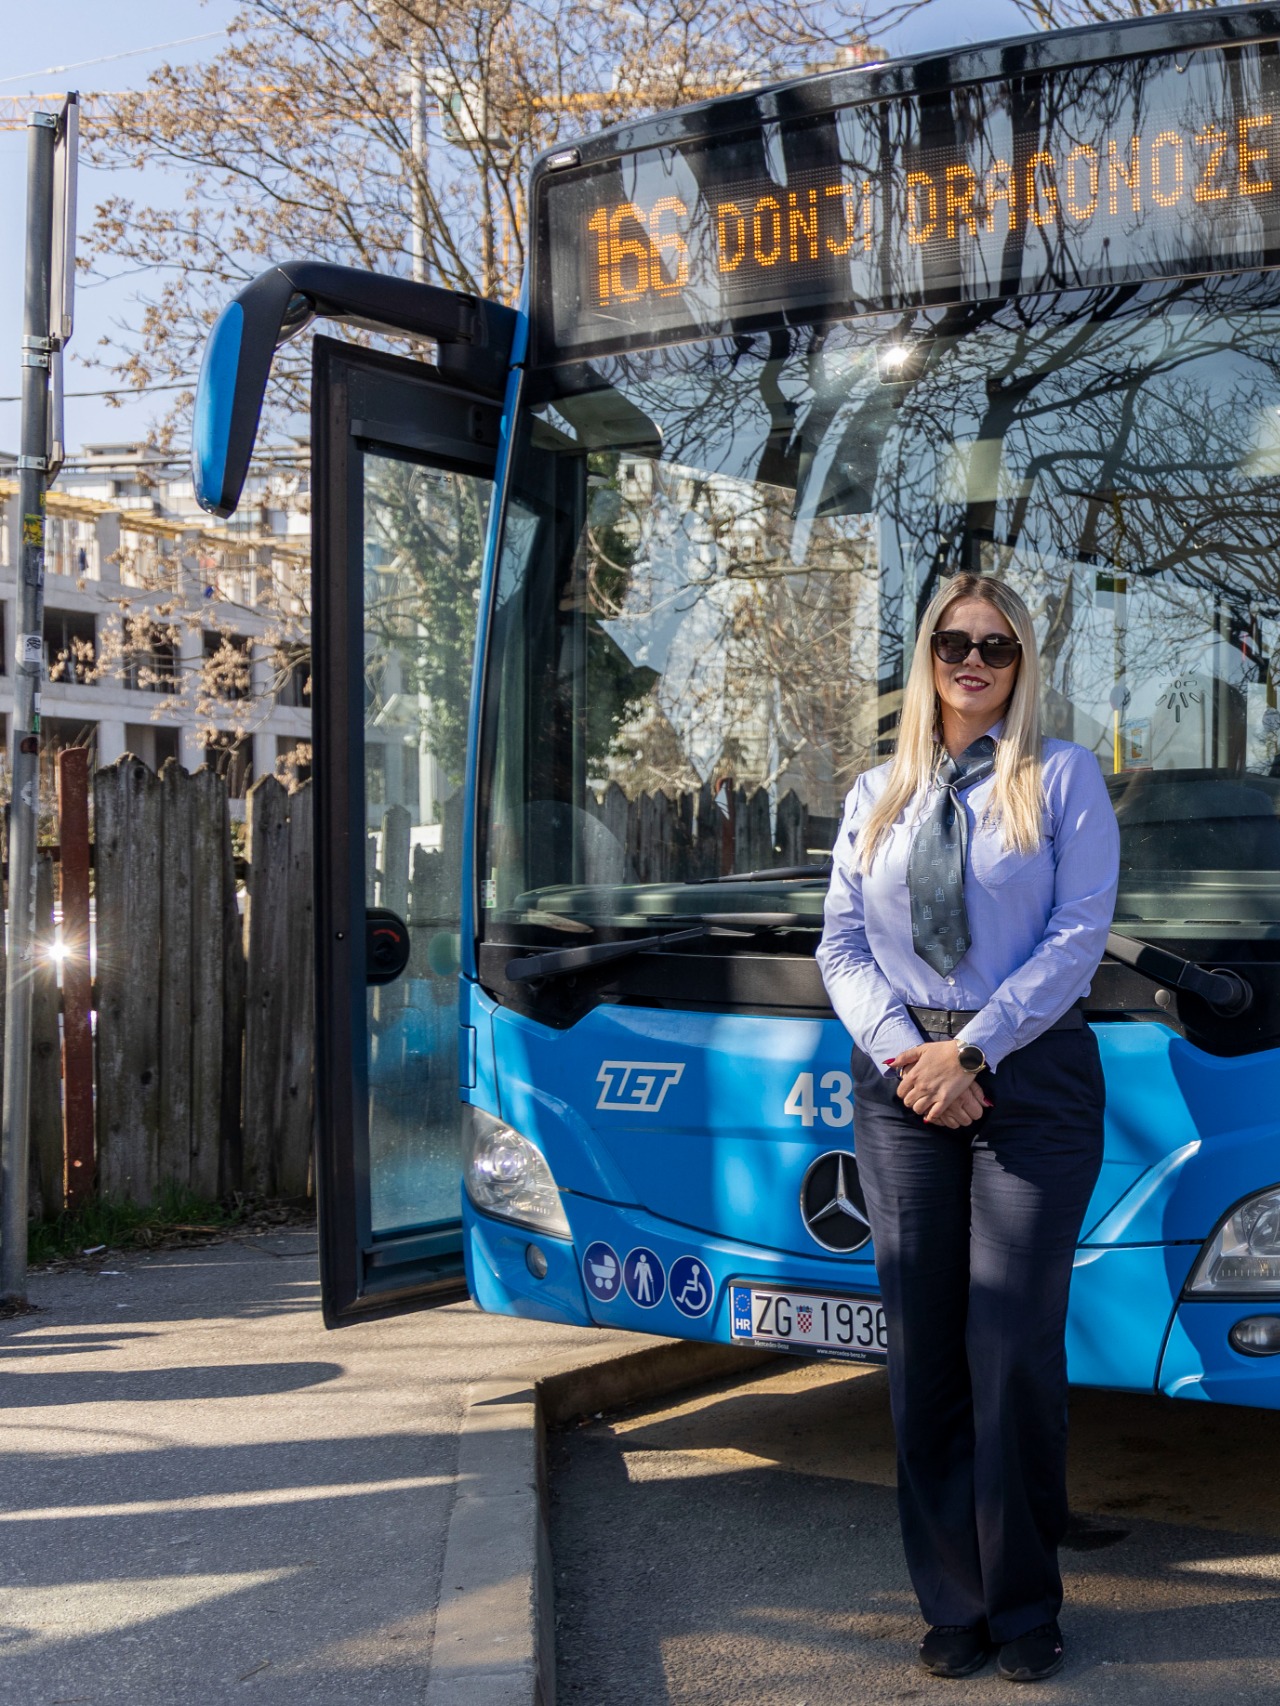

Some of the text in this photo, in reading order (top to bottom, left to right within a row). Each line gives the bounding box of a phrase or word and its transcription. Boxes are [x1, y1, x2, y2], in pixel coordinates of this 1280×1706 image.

[588, 195, 688, 306] 166
[717, 181, 872, 273] DONJI
[735, 1317, 751, 1331] HR
[755, 1295, 792, 1337] ZG
